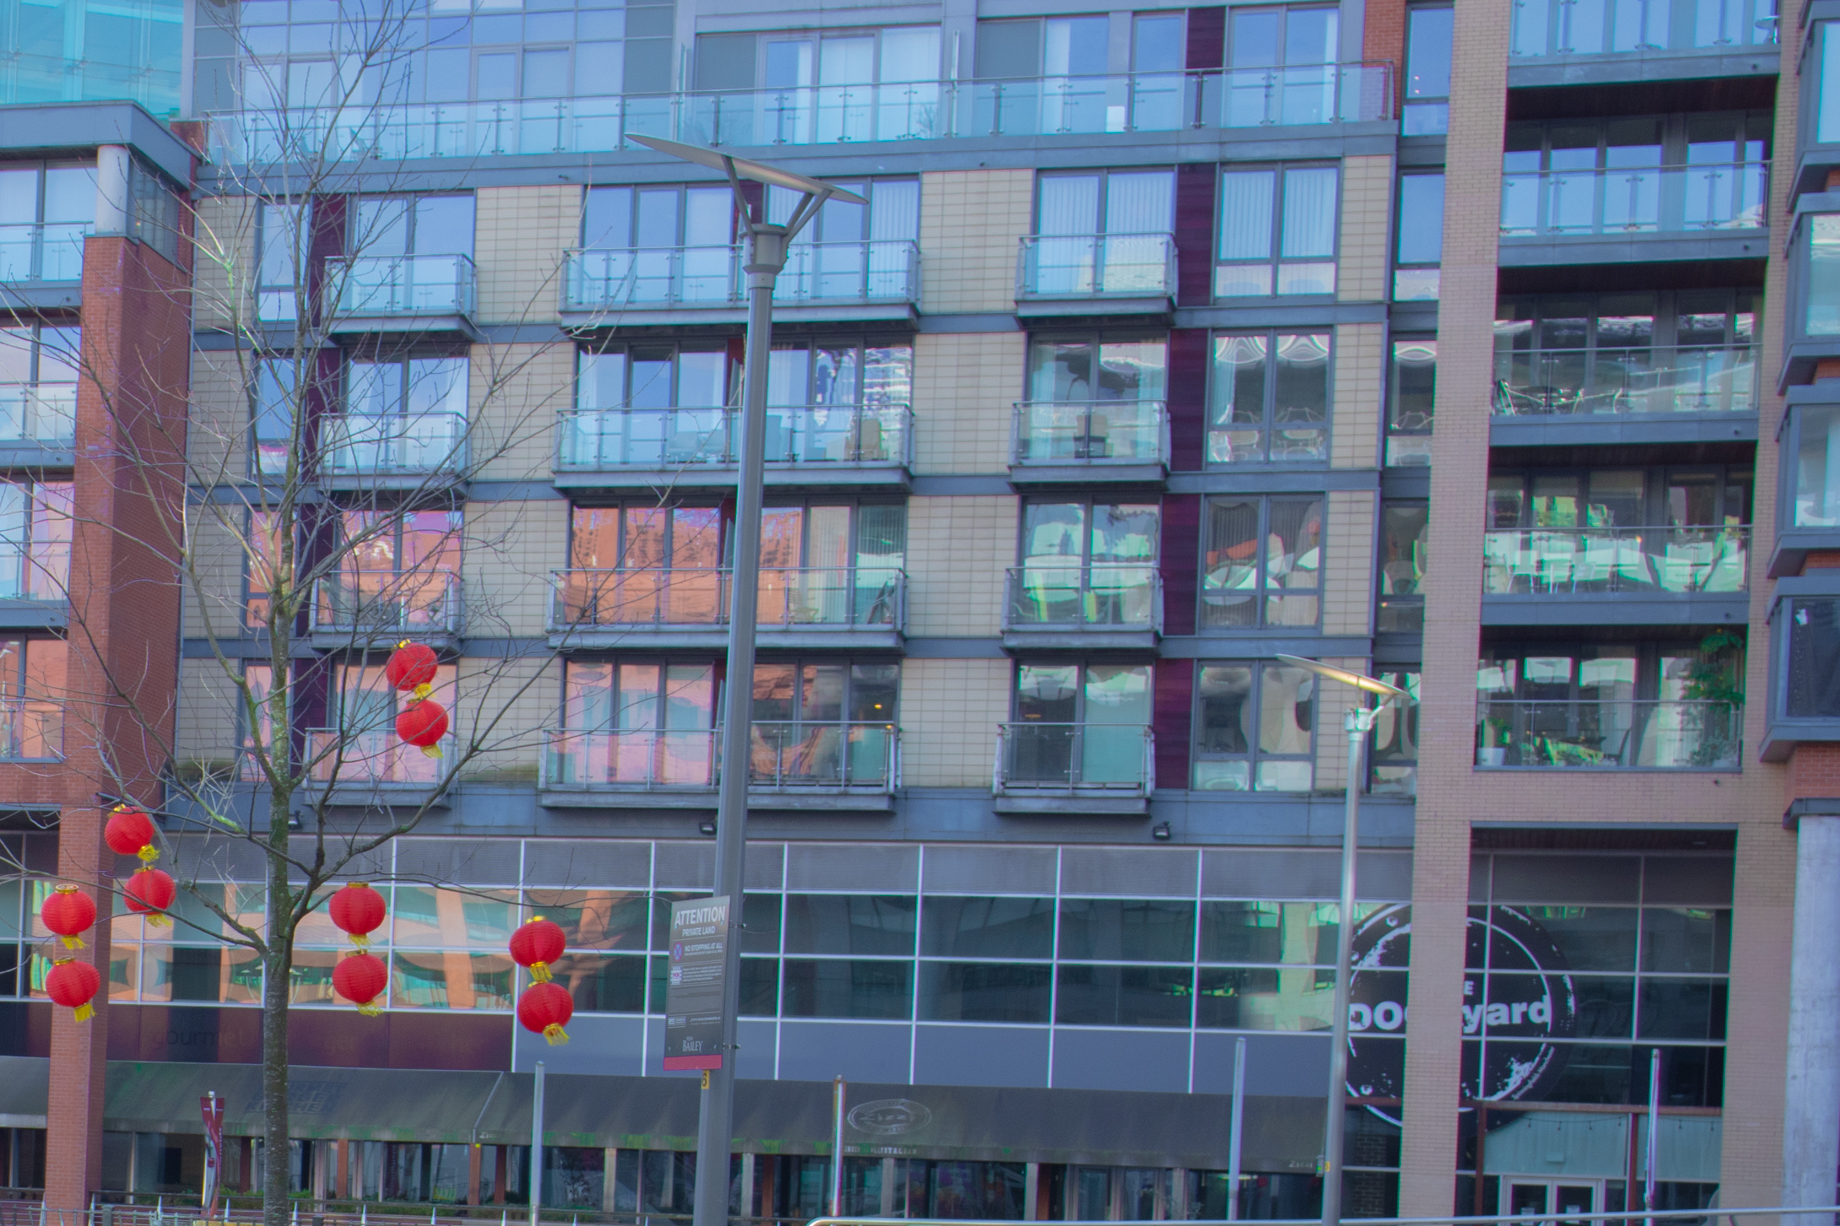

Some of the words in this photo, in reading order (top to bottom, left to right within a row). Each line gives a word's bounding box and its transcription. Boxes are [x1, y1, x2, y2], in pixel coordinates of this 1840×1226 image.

[674, 906, 726, 926] ATTENTION
[682, 927, 701, 937] PRIVATE
[702, 926, 716, 935] LAND
[682, 1039, 703, 1053] BAILEY
